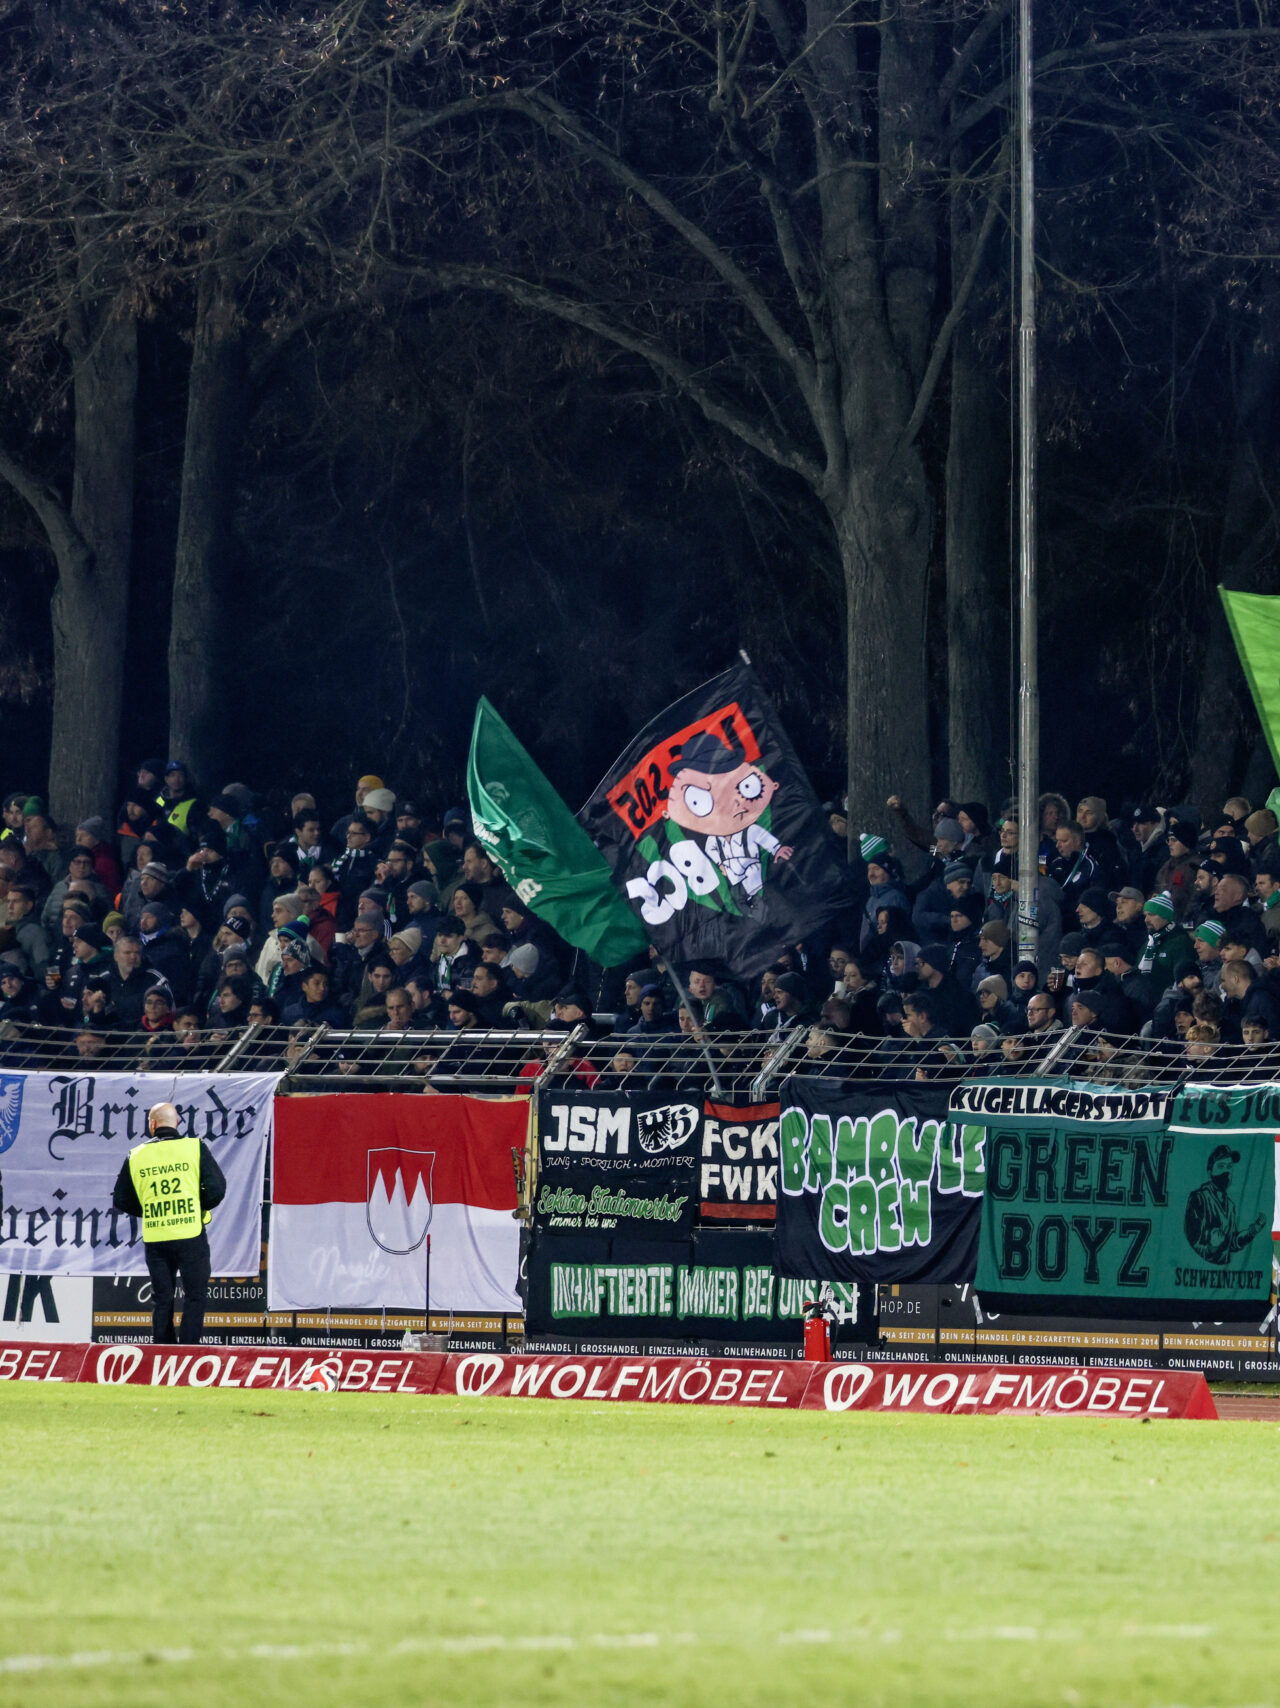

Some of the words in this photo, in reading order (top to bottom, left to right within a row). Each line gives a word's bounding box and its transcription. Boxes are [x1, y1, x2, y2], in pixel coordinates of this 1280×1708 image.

[949, 1086, 1165, 1121] KUGELLAGERSTADT
[48, 1076, 257, 1160] Briade
[543, 1104, 632, 1154] JSM
[701, 1119, 780, 1160] FCK
[139, 1162, 190, 1178] STEWARD
[987, 1133, 1175, 1207] GREEN
[150, 1177, 182, 1197] 182
[701, 1163, 778, 1201] FWK
[144, 1198, 195, 1219] EMPIRE
[537, 1184, 588, 1215] Sektion
[549, 1214, 583, 1228] immer
[585, 1214, 599, 1228] bei
[818, 1175, 932, 1256] CREW
[1000, 1213, 1152, 1286] BOYZ
[1175, 1267, 1264, 1290] SCHWEINFURT
[677, 1266, 739, 1317] IMMER
[233, 1316, 258, 1324] SHISHA
[297, 1317, 314, 1325] DEIN
[317, 1318, 362, 1326] FACHHANDEL
[365, 1318, 378, 1327] FÜR
[467, 1321, 483, 1329] SEIT
[485, 1322, 501, 1330] 2014
[98, 1335, 154, 1344] ONLINEHANDE
[301, 1337, 362, 1347] ONLINEHANDEL
[899, 1331, 916, 1339] SEIT
[918, 1332, 935, 1340] 2014
[941, 1332, 958, 1340] DEIN
[961, 1332, 1009, 1342] FACHHANDEL
[1012, 1333, 1026, 1342] FÜR
[1029, 1334, 1081, 1344] E-ZIGARETTEN
[1084, 1336, 1089, 1344] &
[1092, 1336, 1119, 1345] SHISHA
[1122, 1337, 1139, 1346] SEIT
[1141, 1338, 1159, 1346] 2014
[1165, 1337, 1182, 1346] DEIN
[1185, 1338, 1235, 1348] FACHHANDEL
[1238, 1338, 1252, 1348] FÜR
[581, 1344, 640, 1355] GROSSHANDEL
[649, 1345, 709, 1356] EINZELHANDEL
[724, 1347, 788, 1357] ONLINEHANDEL
[867, 1351, 930, 1361] EINZELHANDEL
[945, 1353, 1009, 1364] ONLINEHANDEL
[1019, 1355, 1080, 1366] GROSSHANDEL
[1090, 1357, 1153, 1368] EINZELHANDEL
[1169, 1359, 1235, 1370] ONLINEHANDEL
[510, 1361, 788, 1403] WOLFMÖBEL
[882, 1369, 1169, 1413] WOLFMÖBEL
